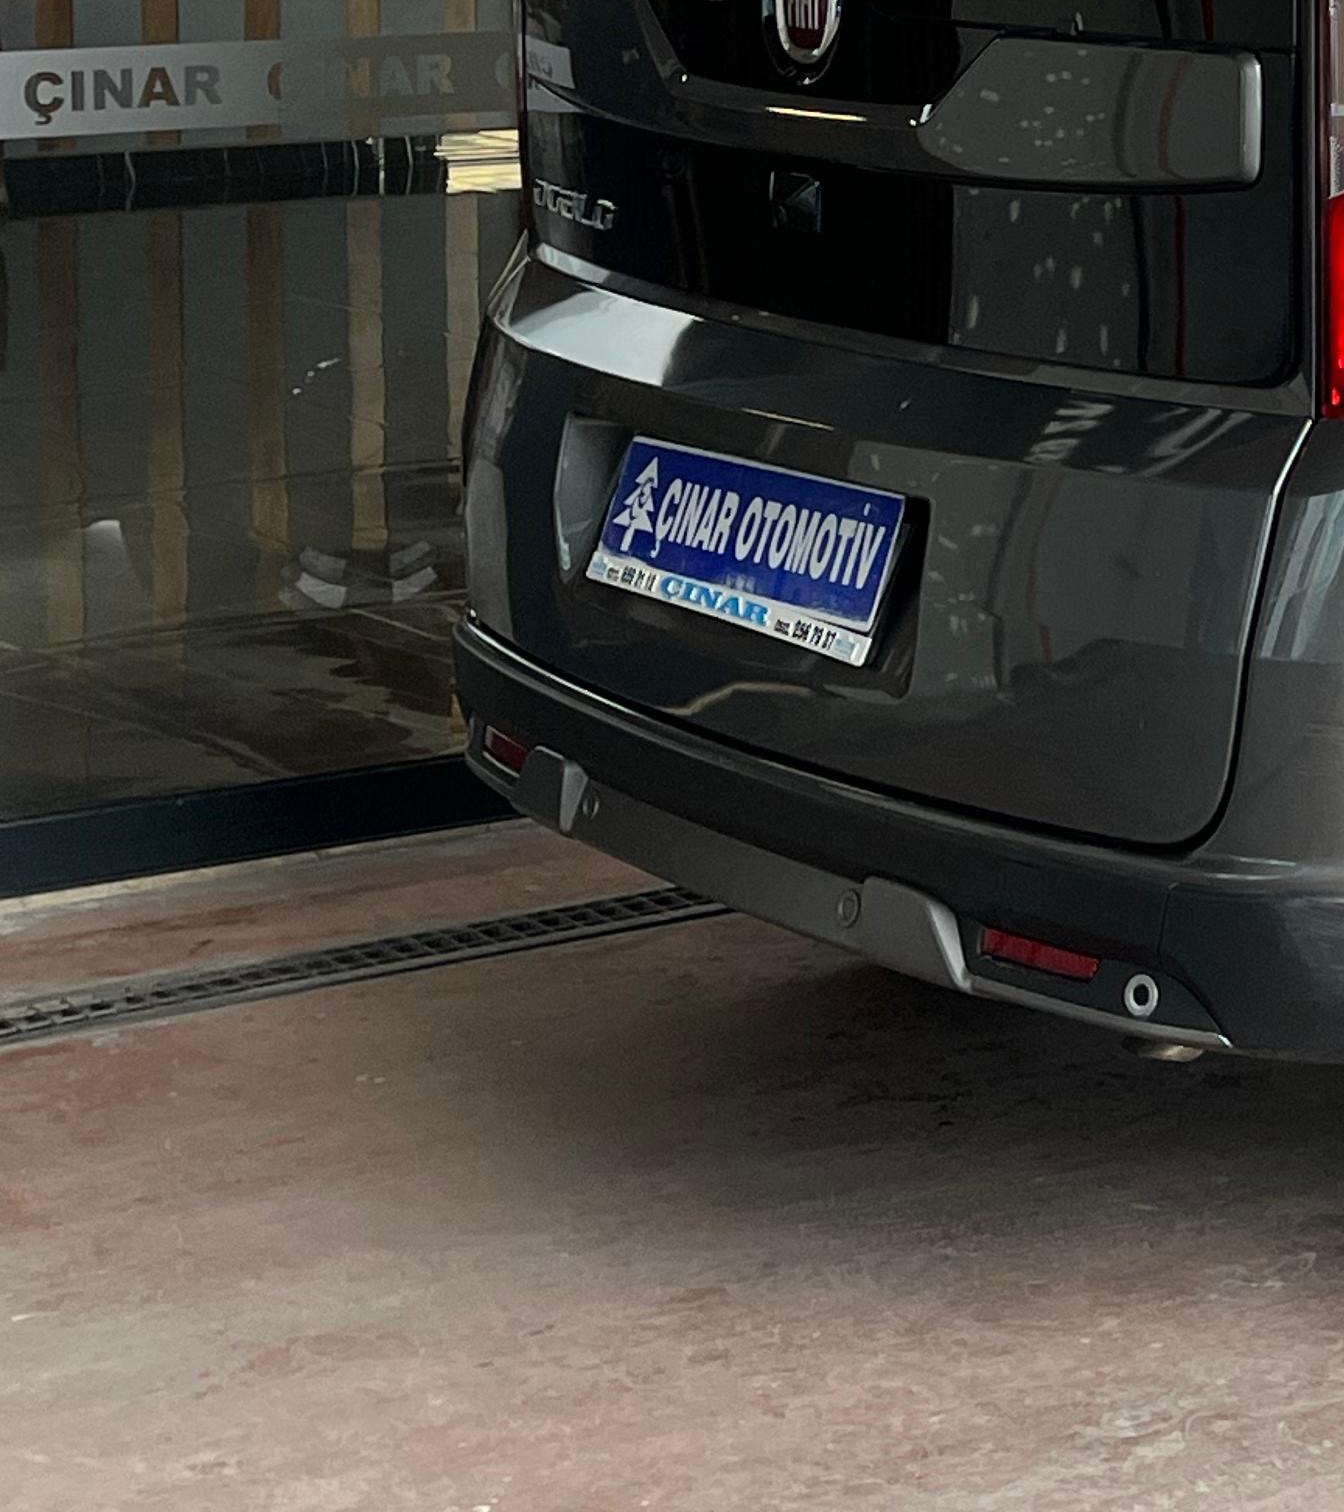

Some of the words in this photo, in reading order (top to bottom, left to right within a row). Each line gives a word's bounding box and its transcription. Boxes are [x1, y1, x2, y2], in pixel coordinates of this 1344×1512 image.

[24, 64, 222, 125] ÇINAR
[651, 478, 740, 558] ÇINAR
[735, 496, 887, 590] OTOMOTİV
[660, 574, 769, 628] ÇINAR
